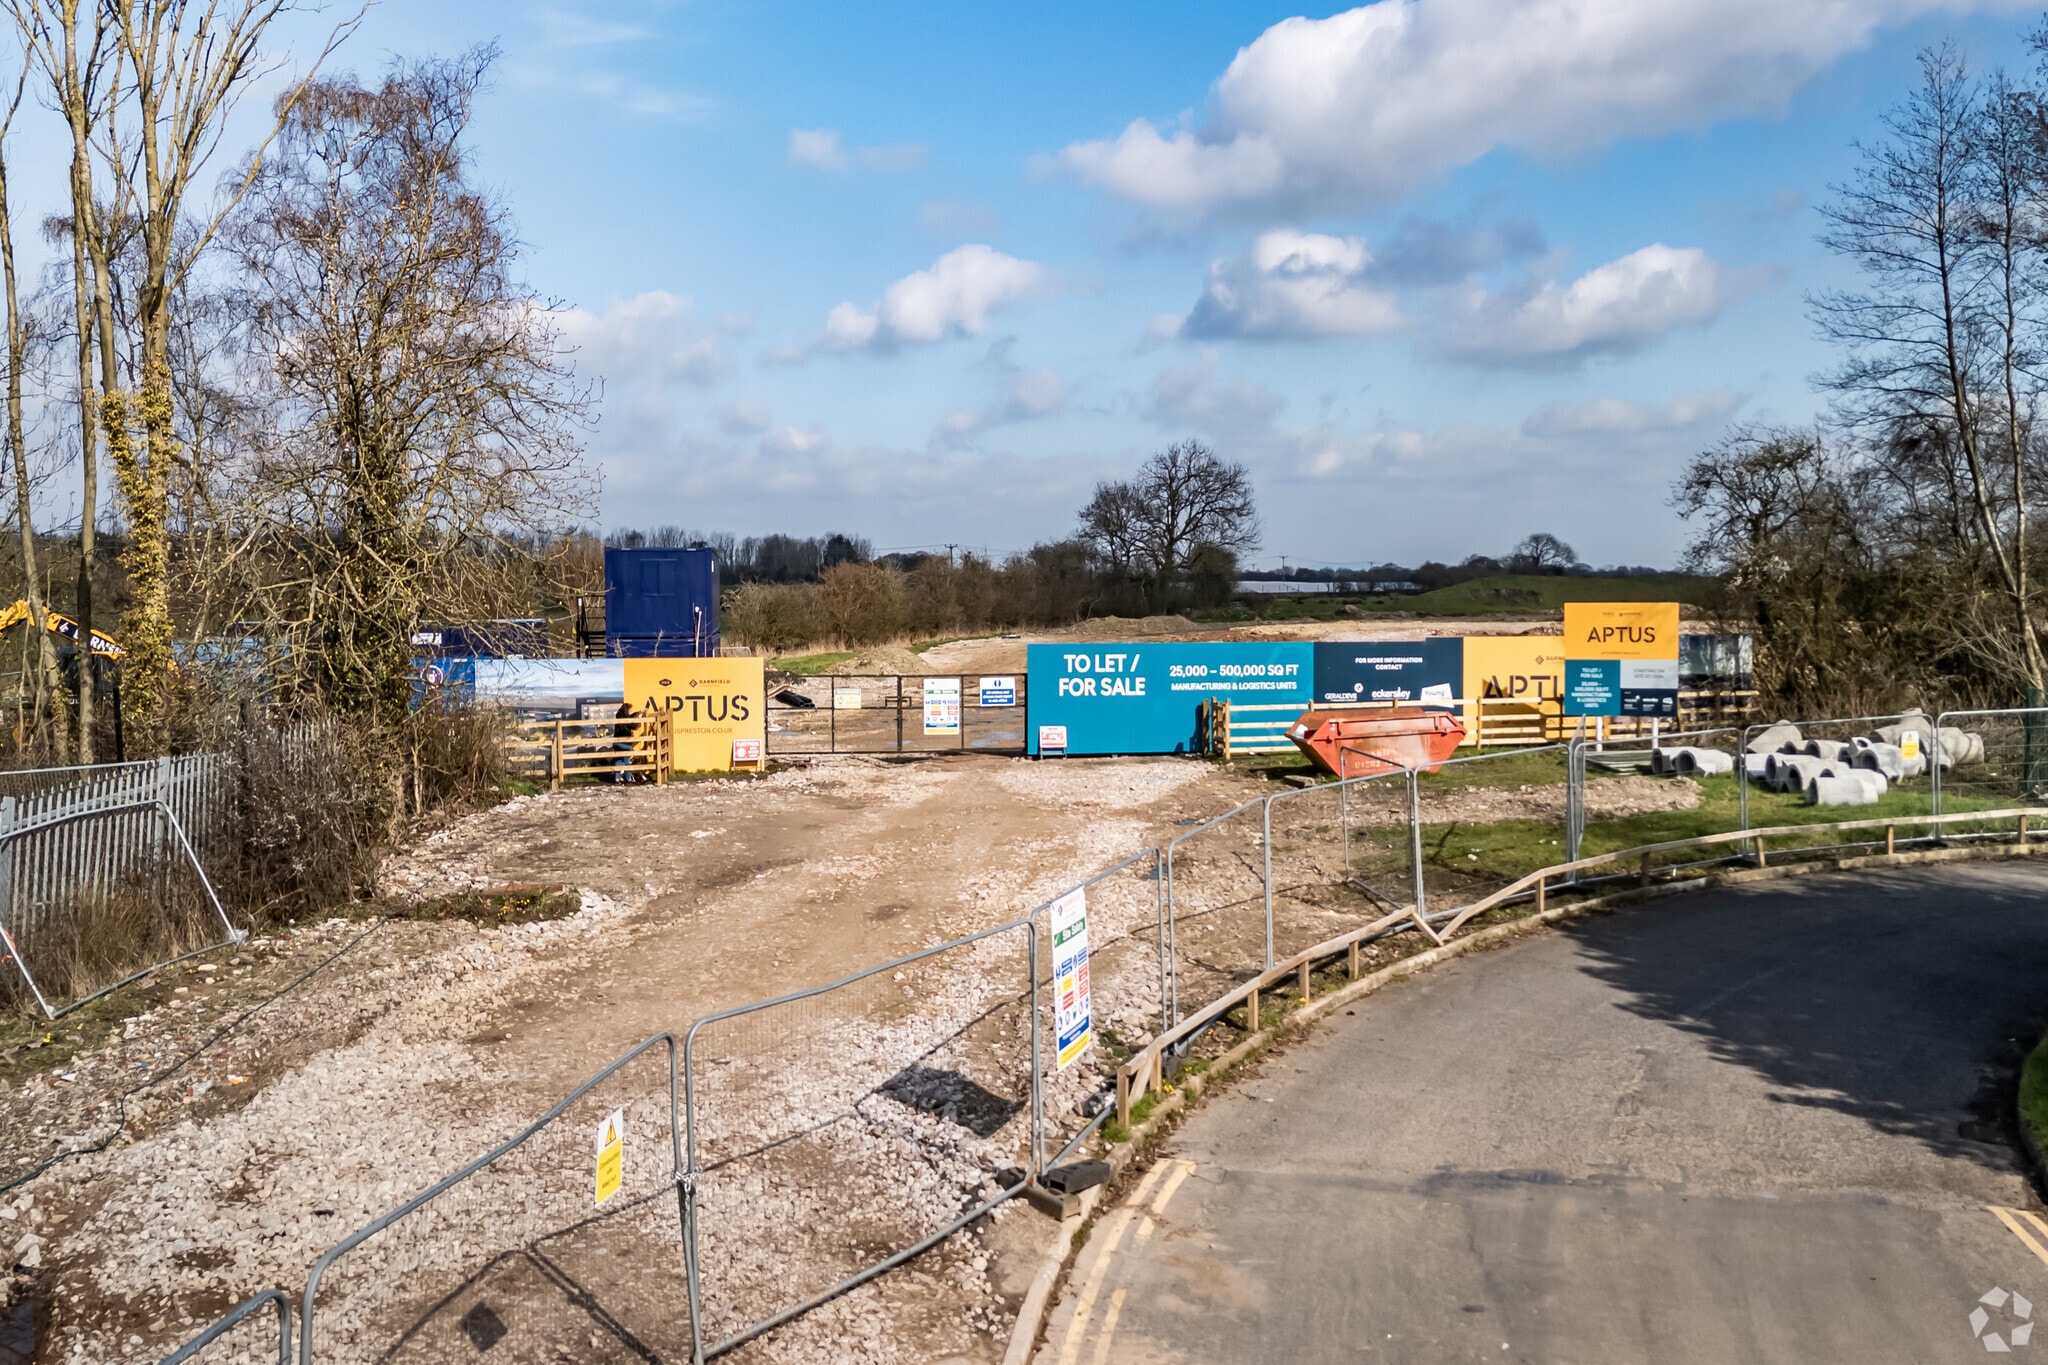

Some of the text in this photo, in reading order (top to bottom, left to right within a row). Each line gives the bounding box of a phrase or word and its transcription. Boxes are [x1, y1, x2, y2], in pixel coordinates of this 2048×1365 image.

[1587, 627, 1656, 643] APTUS
[1063, 654, 1140, 673] TO LET /
[1169, 665, 1208, 678] 25,000
[1220, 664, 1265, 677] 500,000
[1267, 664, 1284, 676] SQ
[1285, 664, 1299, 675] FT
[1058, 677, 1146, 696] FOR SALE
[1171, 681, 1297, 691] MANUFACTURING & LOGISTICS UNITS
